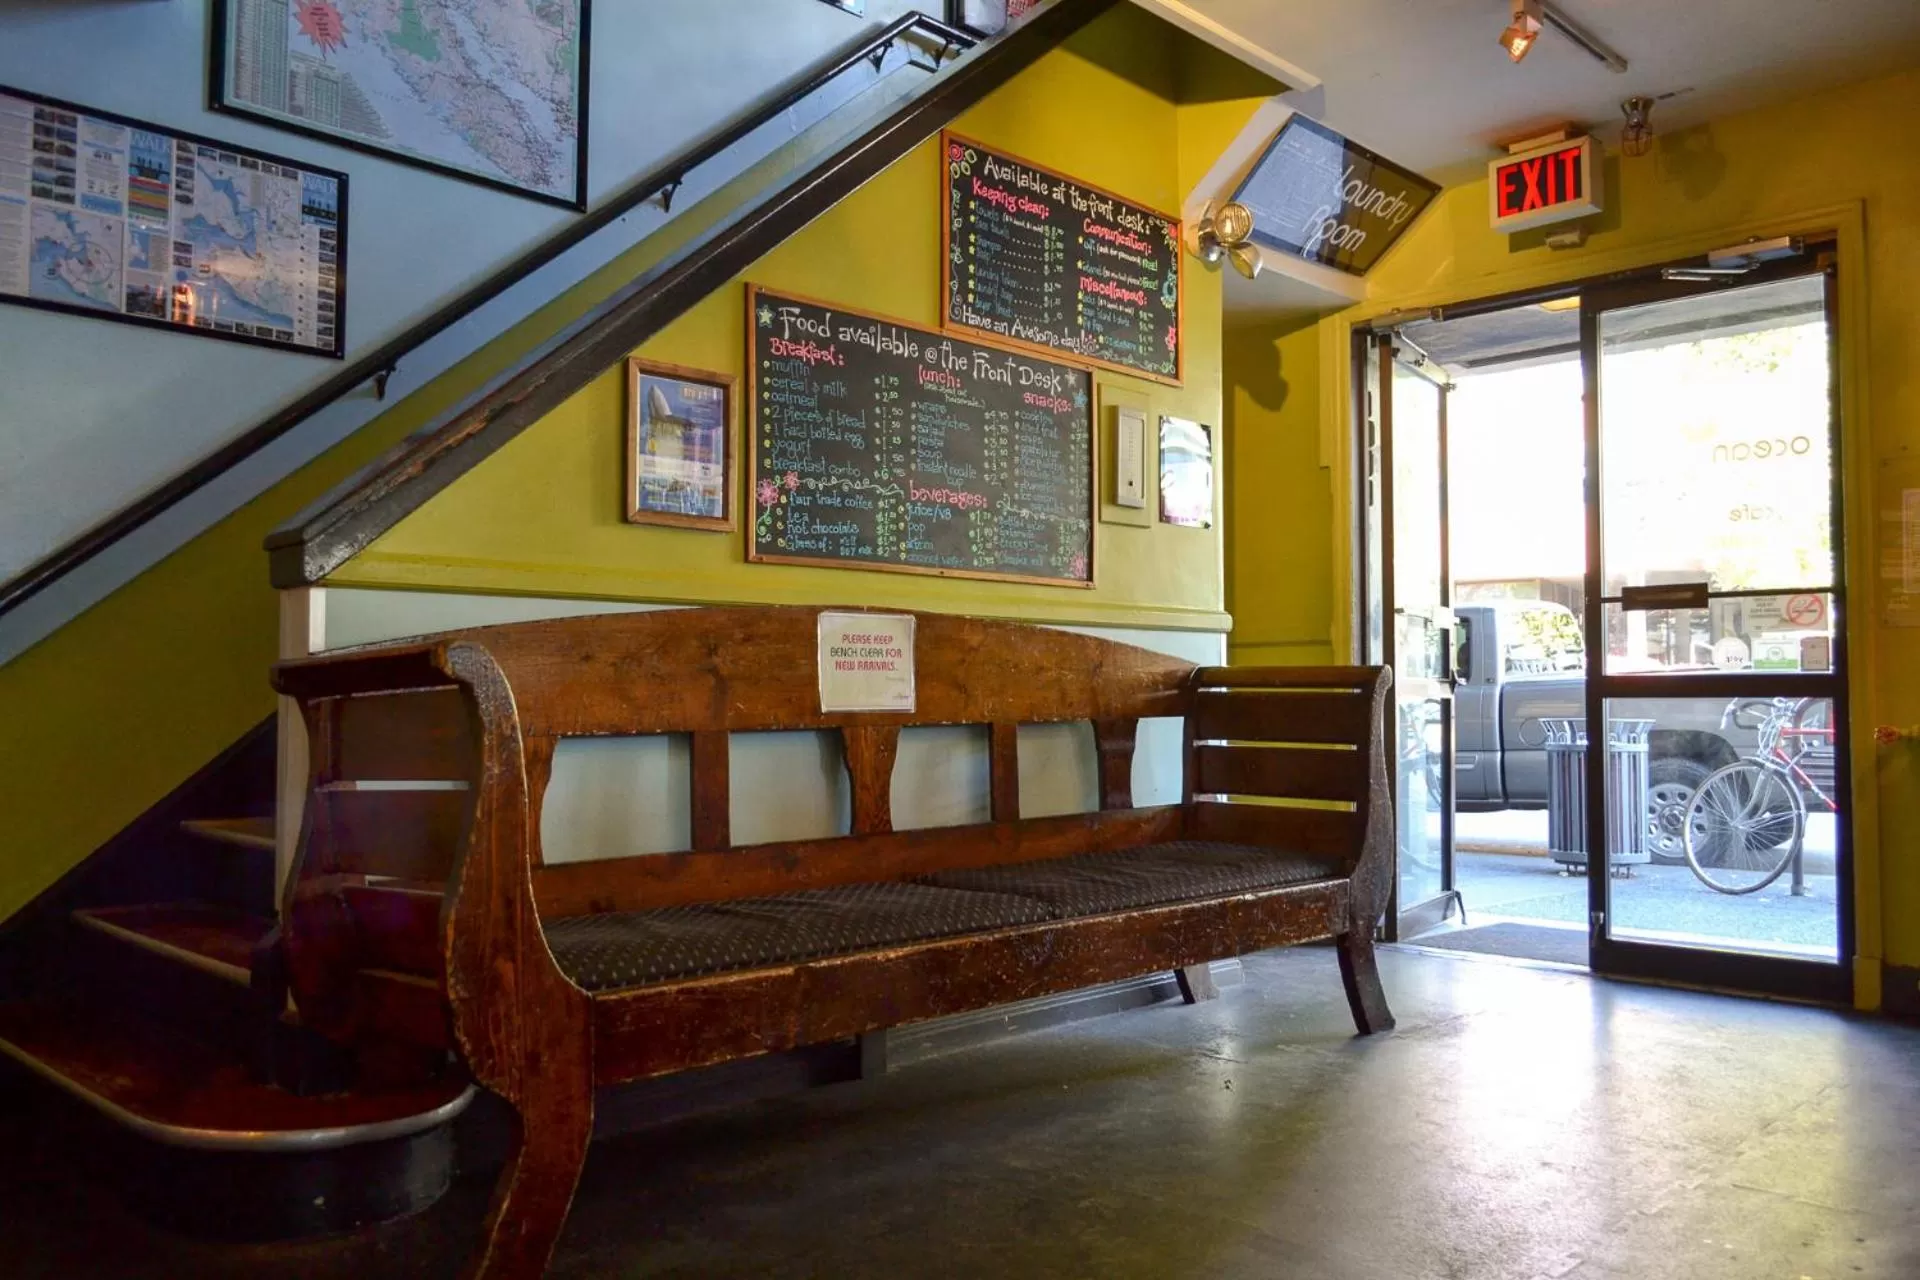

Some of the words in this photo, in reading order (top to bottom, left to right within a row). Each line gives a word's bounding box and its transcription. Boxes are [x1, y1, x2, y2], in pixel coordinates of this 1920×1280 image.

[983, 155, 1049, 195] Available
[1052, 181, 1067, 204] at
[1069, 185, 1088, 212] the
[1088, 193, 1114, 222] front
[1117, 206, 1151, 235] desk:
[1498, 146, 1581, 218] EXIT
[973, 176, 1018, 213] Keeping
[1018, 196, 1050, 219] clean:
[1334, 164, 1415, 231] Laundry
[1302, 205, 1367, 252] Room
[963, 304, 992, 329] Have
[994, 319, 1009, 336] an
[778, 306, 832, 340] Food
[838, 322, 919, 358] available
[925, 347, 938, 364] @
[939, 340, 968, 371] the
[972, 350, 1016, 386] Front
[1019, 366, 1062, 396] Desk
[772, 360, 810, 380] muffin
[772, 390, 818, 411] oatmeal
[823, 381, 848, 397] milk
[772, 405, 781, 418] 2
[1023, 392, 1073, 415] snacks:
[909, 479, 988, 510] beverages:
[830, 646, 857, 657] BENCH
[859, 647, 884, 658] CLEAR
[885, 647, 902, 659] FOR
[841, 634, 871, 644] PLEASE
[873, 635, 893, 645] KEEP
[835, 660, 855, 671] NEW
